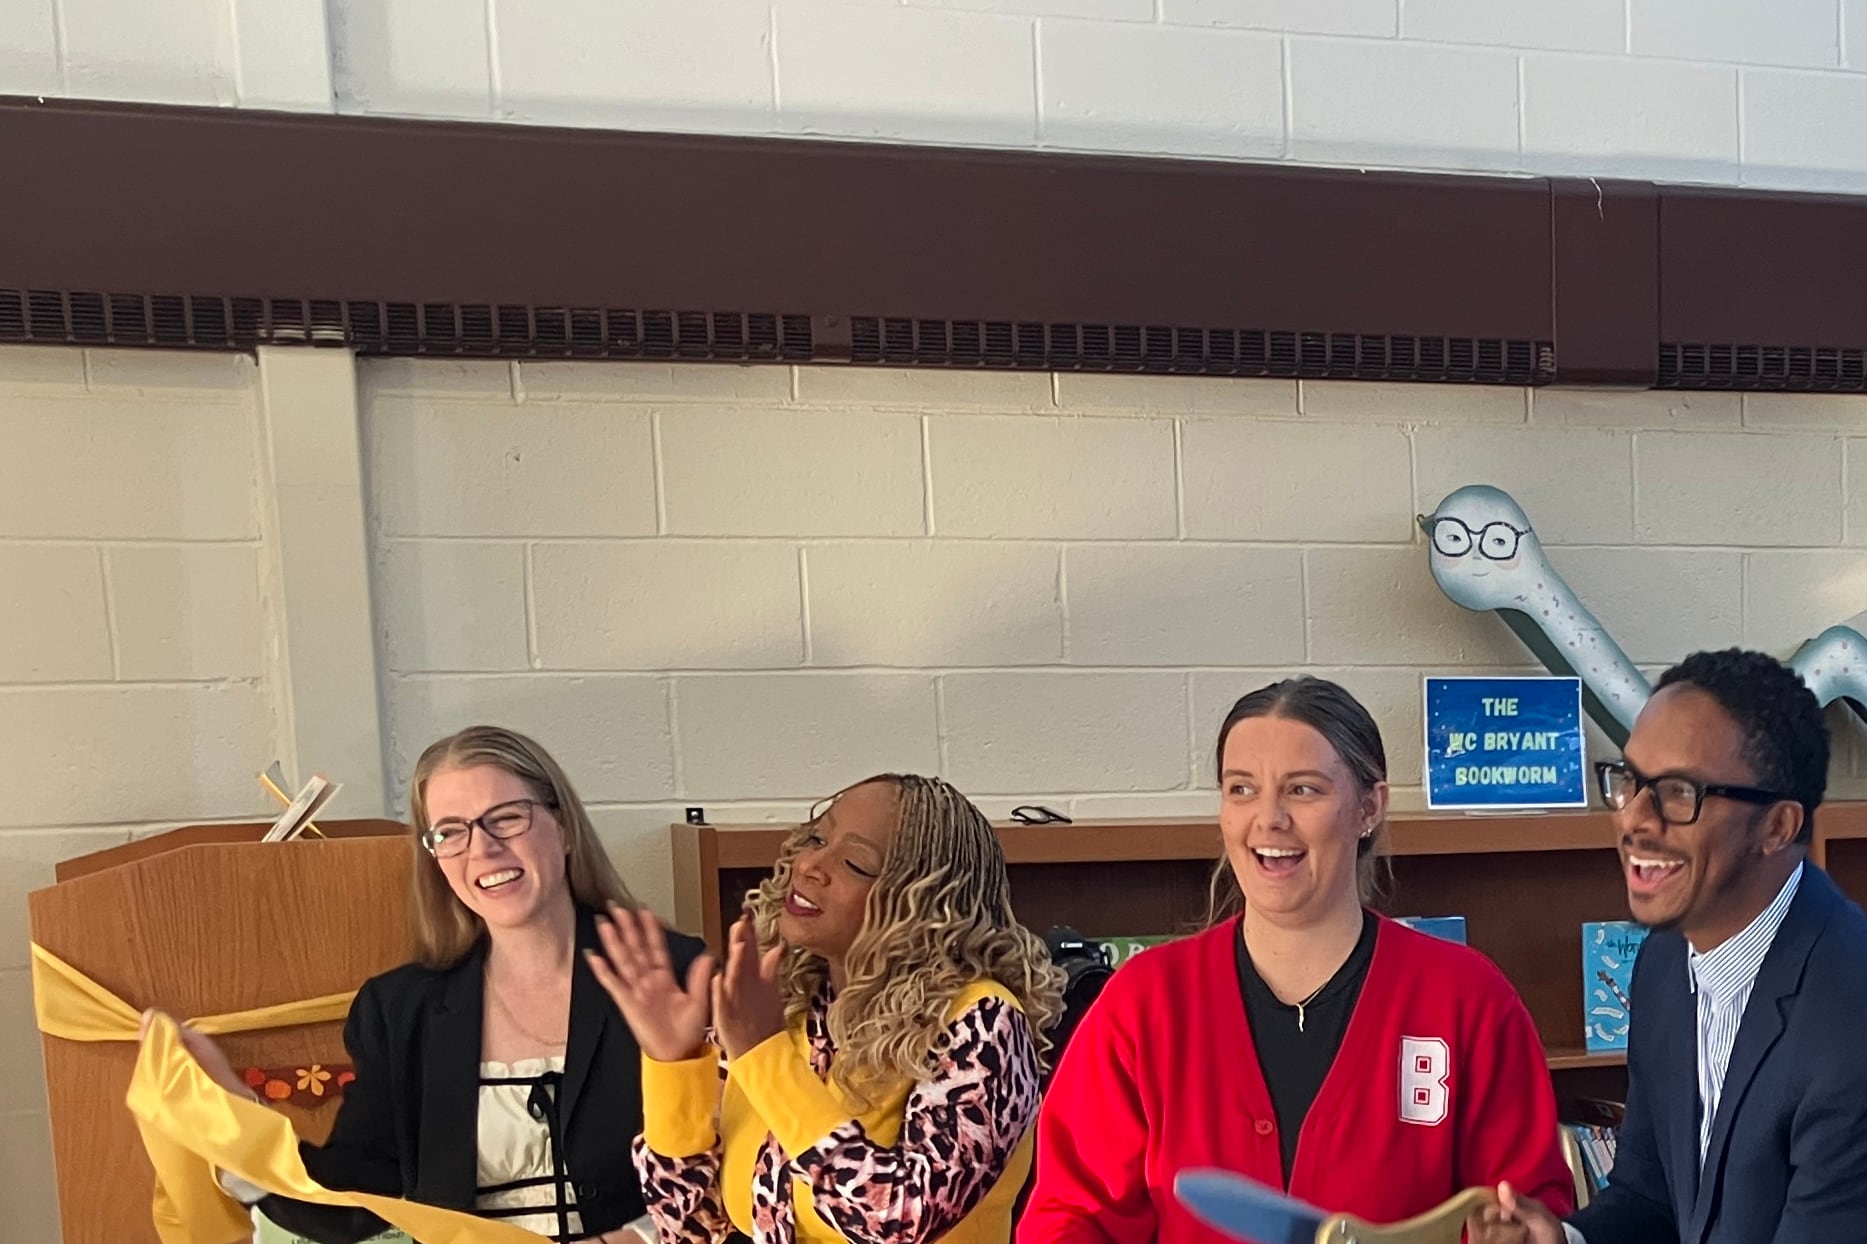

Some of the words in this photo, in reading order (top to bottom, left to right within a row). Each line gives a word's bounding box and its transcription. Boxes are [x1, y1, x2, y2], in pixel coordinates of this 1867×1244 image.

[1482, 698, 1518, 716] THE
[1449, 732, 1477, 750] WC
[1484, 732, 1559, 750] BRYANT
[1455, 766, 1557, 786] BOOKWORM
[1398, 1035, 1450, 1126] B
